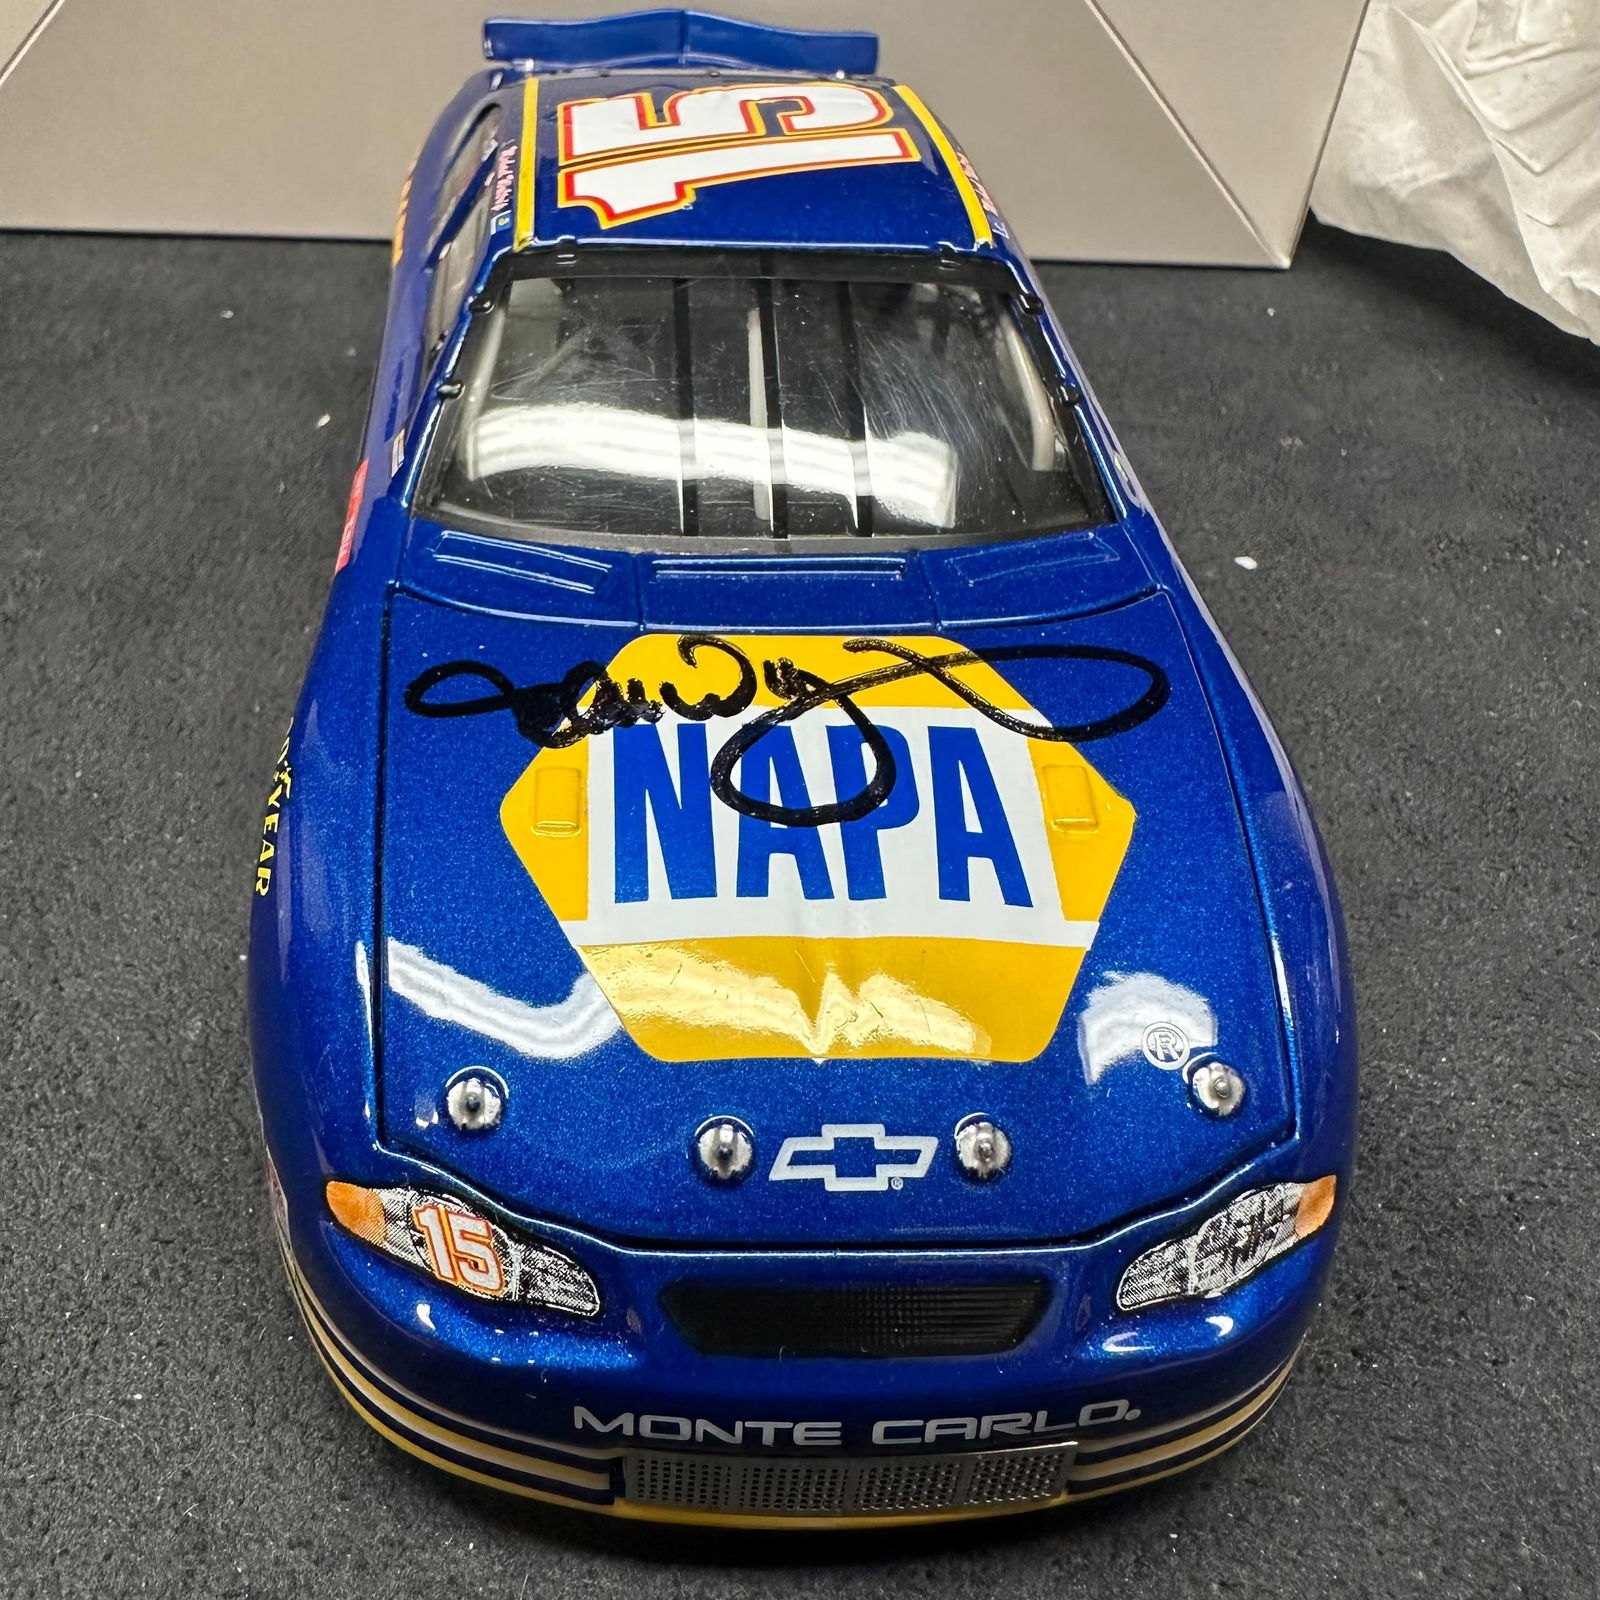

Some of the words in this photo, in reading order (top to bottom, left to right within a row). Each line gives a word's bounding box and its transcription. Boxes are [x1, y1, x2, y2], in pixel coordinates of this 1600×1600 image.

[557, 82, 923, 229] 15
[613, 722, 1033, 908] NAPA
[411, 1203, 506, 1297] 15
[574, 1405, 843, 1447] MONTE
